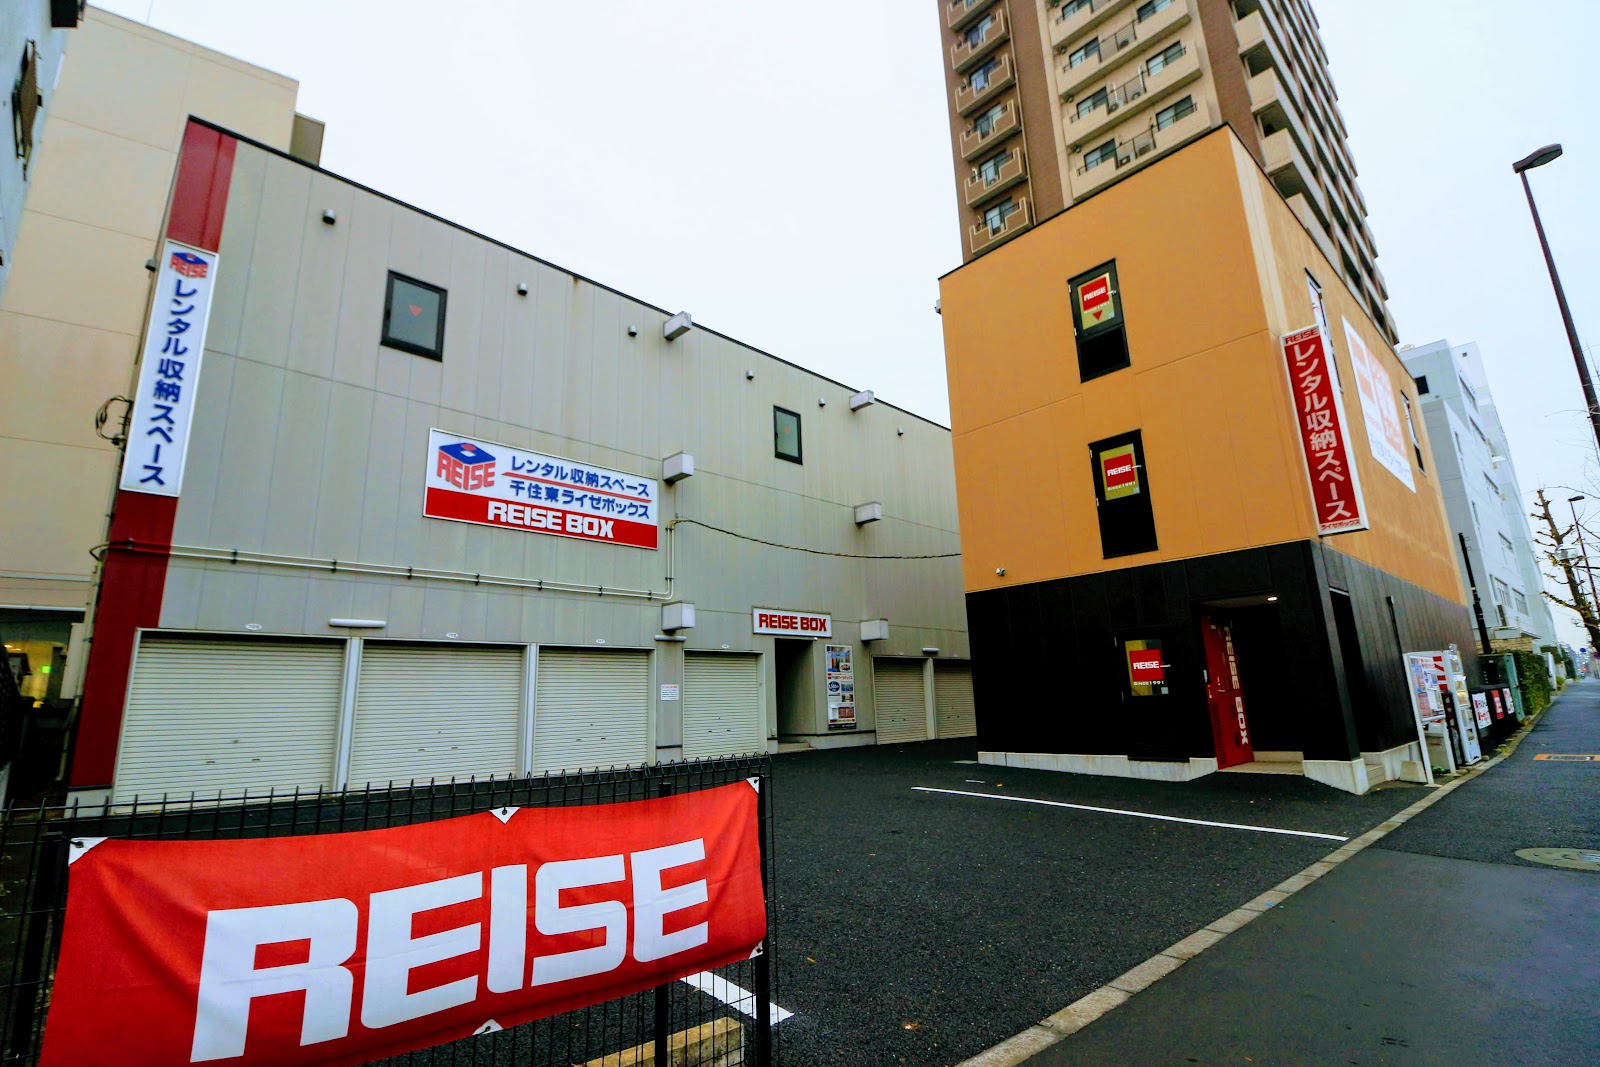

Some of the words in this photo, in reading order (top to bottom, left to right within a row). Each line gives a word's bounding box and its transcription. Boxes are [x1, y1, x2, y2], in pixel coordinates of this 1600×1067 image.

[1285, 328, 1319, 344] REISE
[139, 279, 198, 486] レンタル収納スペース
[1293, 344, 1352, 521] レンタル収納スペース
[436, 450, 496, 491] REISE
[510, 455, 650, 497] レンタル収納スペース
[1107, 464, 1132, 476] REISE
[509, 479, 650, 519] 千住東ライゼボックス
[487, 500, 563, 531] REISE
[565, 513, 615, 539] BOX
[758, 613, 798, 630] REISE
[800, 616, 827, 632] BOX
[1133, 661, 1160, 670] REISE
[1224, 626, 1240, 690] REISE
[1235, 696, 1249, 745] BOX
[189, 837, 709, 1063] REISE
